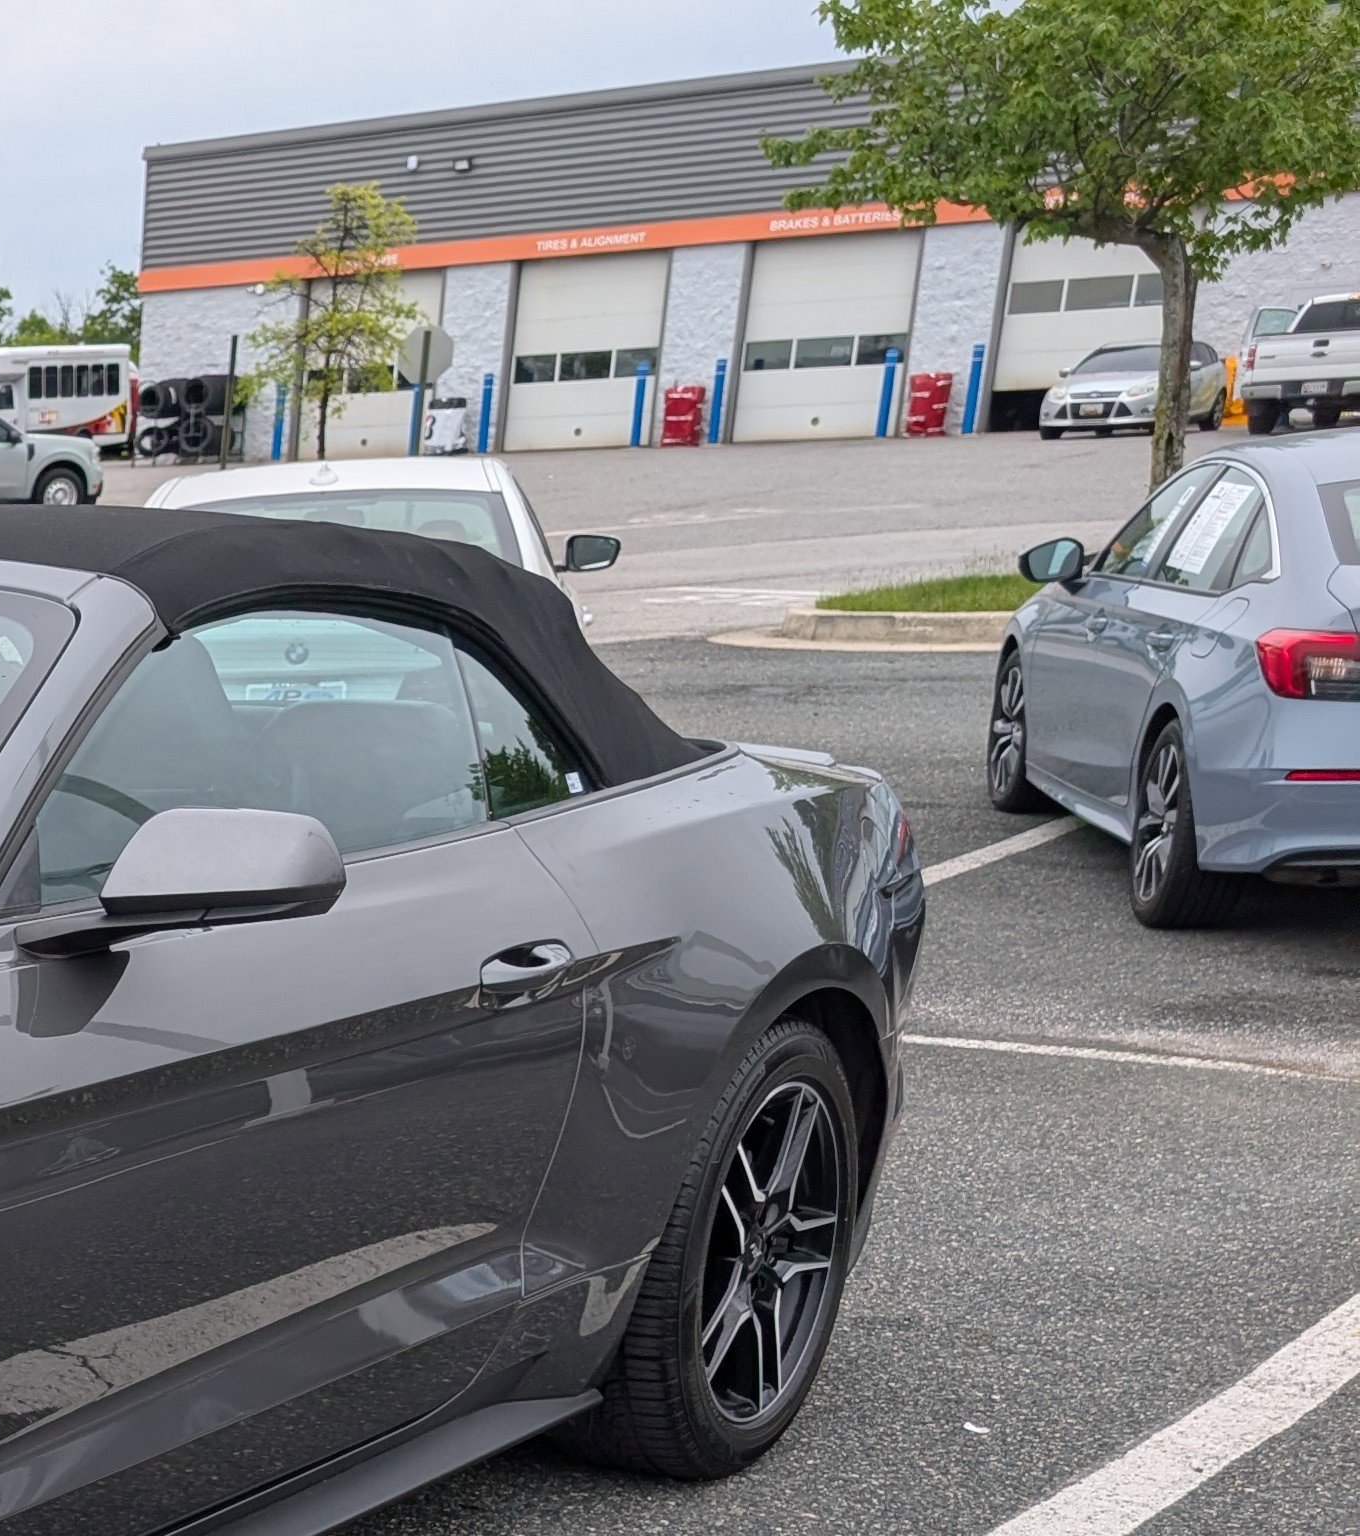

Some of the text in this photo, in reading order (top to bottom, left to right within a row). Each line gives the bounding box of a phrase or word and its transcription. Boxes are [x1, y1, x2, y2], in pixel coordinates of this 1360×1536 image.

[769, 217, 819, 231] BRAKES
[821, 215, 830, 226] &
[536, 239, 568, 252] TIRES
[580, 231, 647, 247] ALIGNMENT
